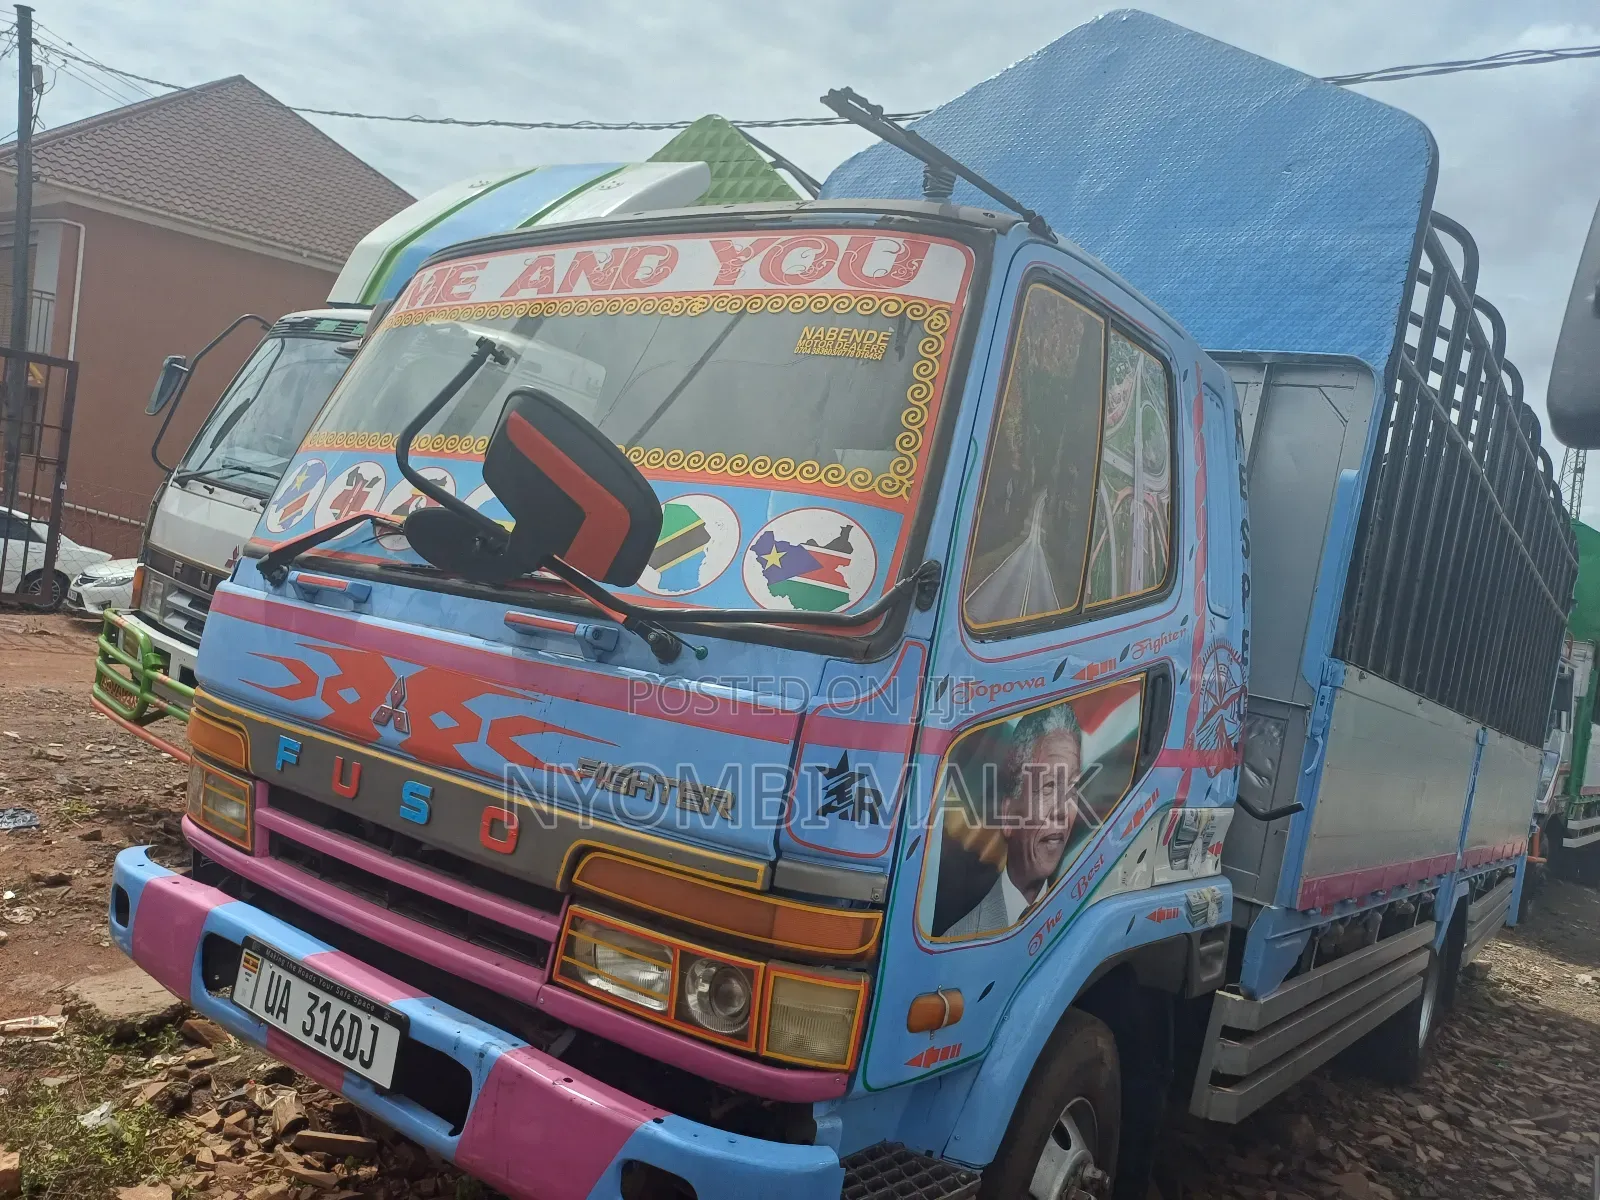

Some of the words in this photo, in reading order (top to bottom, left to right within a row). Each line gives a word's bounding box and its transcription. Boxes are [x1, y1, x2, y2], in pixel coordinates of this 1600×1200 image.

[402, 260, 489, 311] ME
[500, 244, 680, 298] AND
[709, 236, 931, 289] YOU
[796, 339, 833, 349] MOTOR
[835, 341, 886, 354] DEALERS
[799, 325, 892, 347] NABENDE
[951, 675, 1046, 705] Topowa
[1131, 627, 1187, 660] Fighter
[275, 734, 519, 855] FUSO
[574, 757, 736, 822] FIGHTER
[1028, 909, 1063, 957] The
[1070, 853, 1104, 901] Best
[265, 948, 286, 966] Making
[286, 962, 297, 973] the
[298, 967, 317, 983] Roads
[318, 977, 334, 991] Your
[335, 986, 352, 1000] Safe
[353, 995, 376, 1013] Space
[264, 970, 292, 1026] UA
[301, 991, 379, 1070] 316DJ
